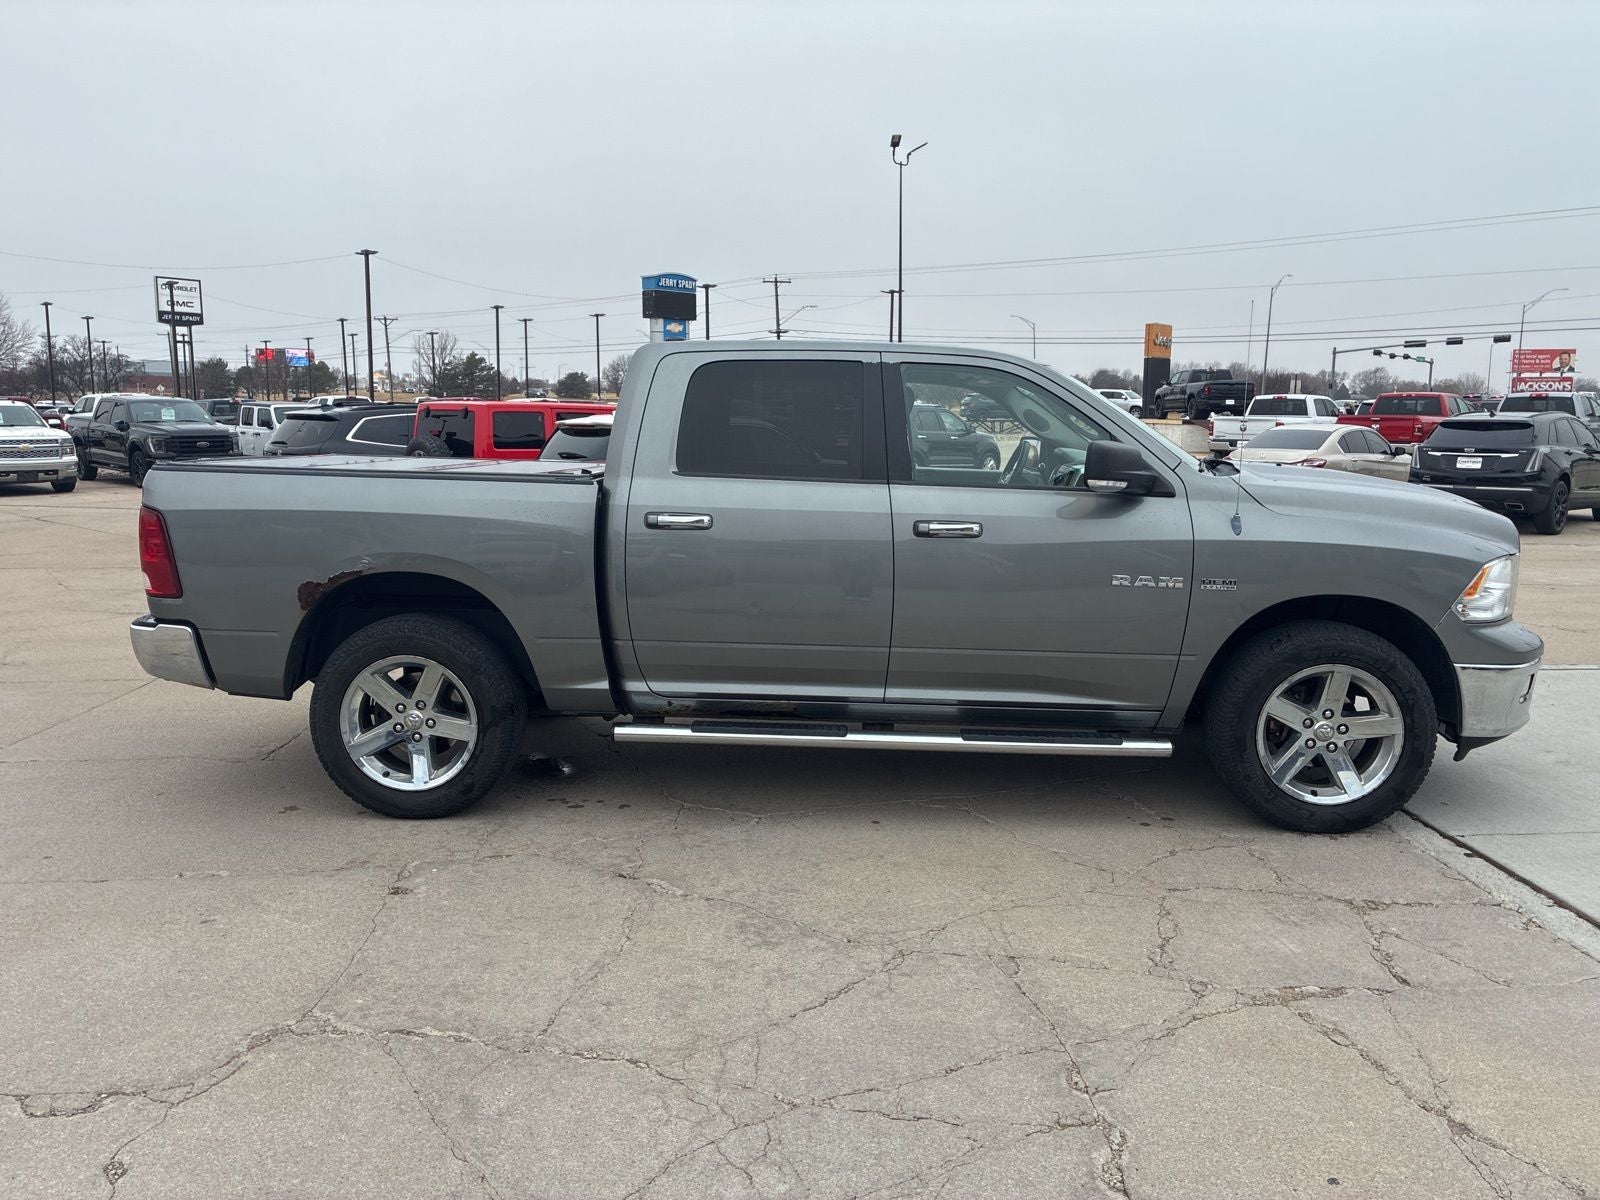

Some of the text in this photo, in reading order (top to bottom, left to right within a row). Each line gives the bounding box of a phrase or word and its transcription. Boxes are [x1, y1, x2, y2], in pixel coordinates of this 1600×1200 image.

[659, 278, 677, 287] JERRY
[161, 283, 197, 292] CHVROLET
[1112, 574, 1184, 588] RAM
